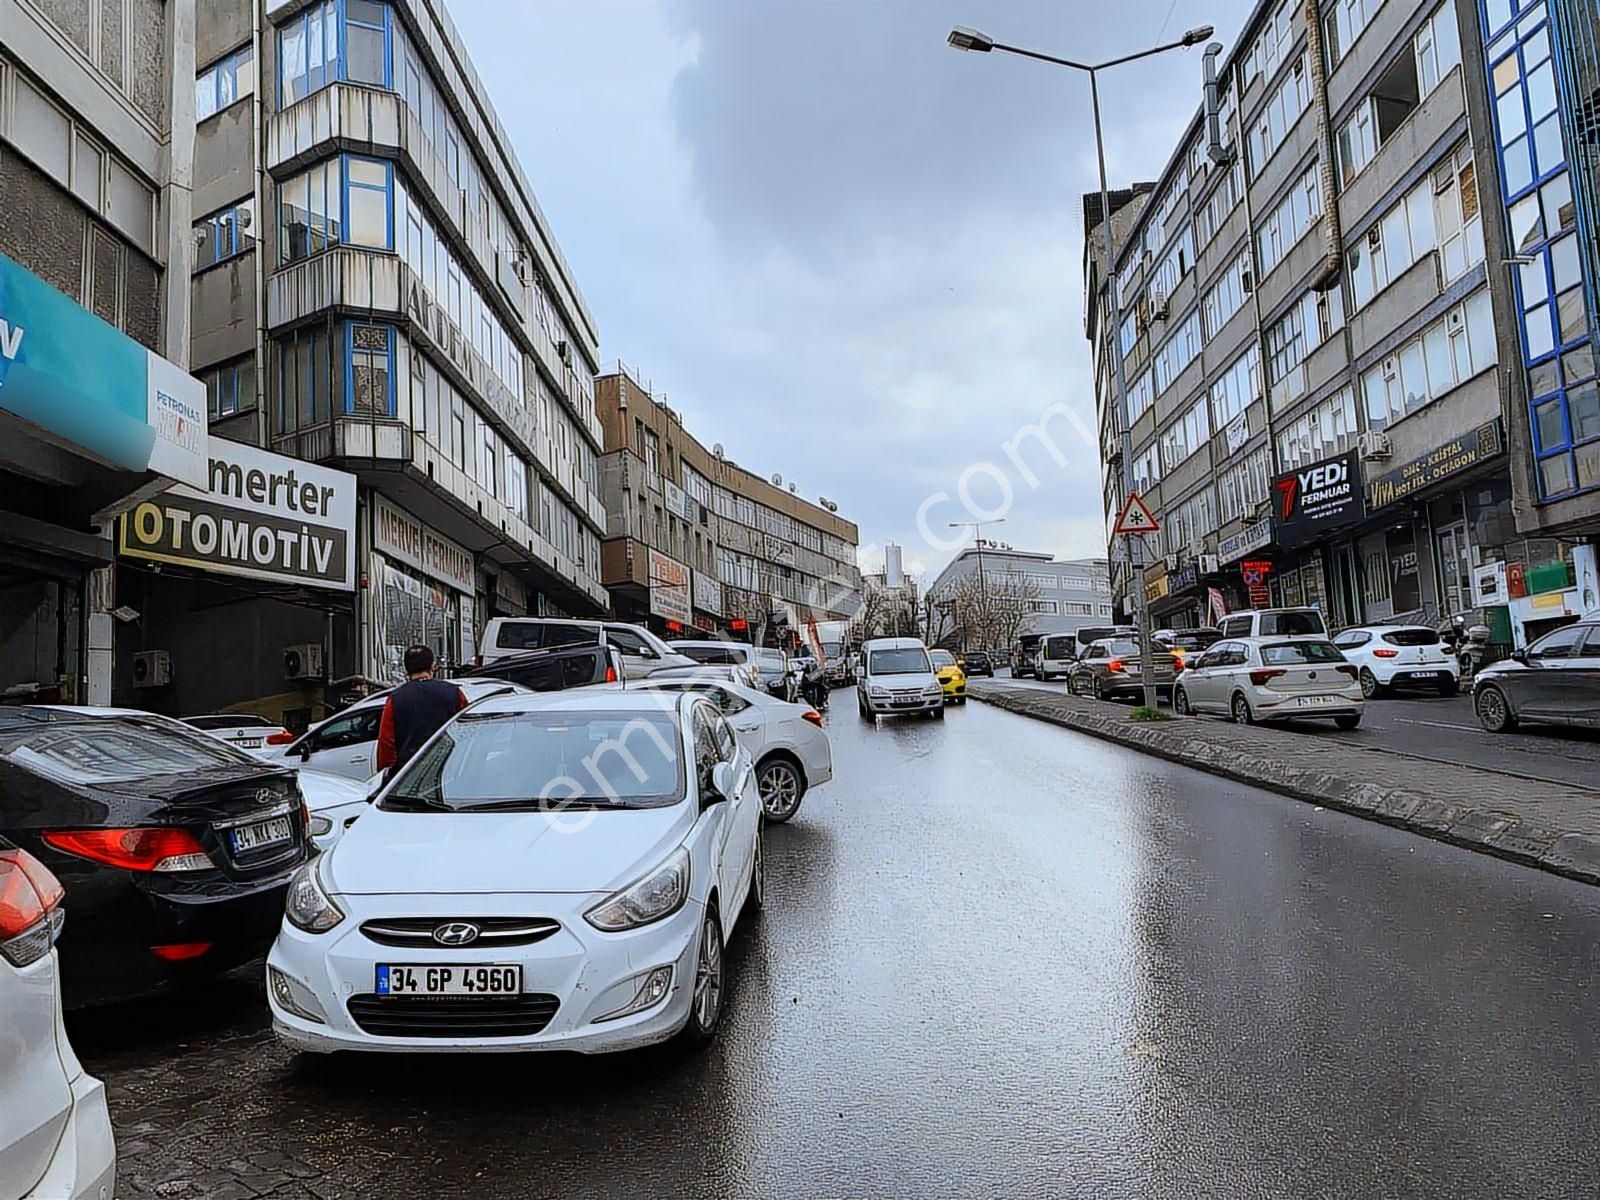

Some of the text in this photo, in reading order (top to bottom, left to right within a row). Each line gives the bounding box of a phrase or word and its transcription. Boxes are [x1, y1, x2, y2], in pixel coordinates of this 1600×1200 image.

[156, 391, 201, 423] PETRONAS
[1432, 450, 1476, 479] OCTAGON
[207, 458, 335, 517] merter
[1274, 475, 1297, 523] 7
[1301, 483, 1351, 507] FERMUAR
[134, 502, 334, 575] OTOMOTİV
[380, 506, 472, 587] MERVE FERMUAR
[392, 968, 417, 992] 34
[426, 968, 452, 992] GP
[462, 968, 516, 992] 4960
